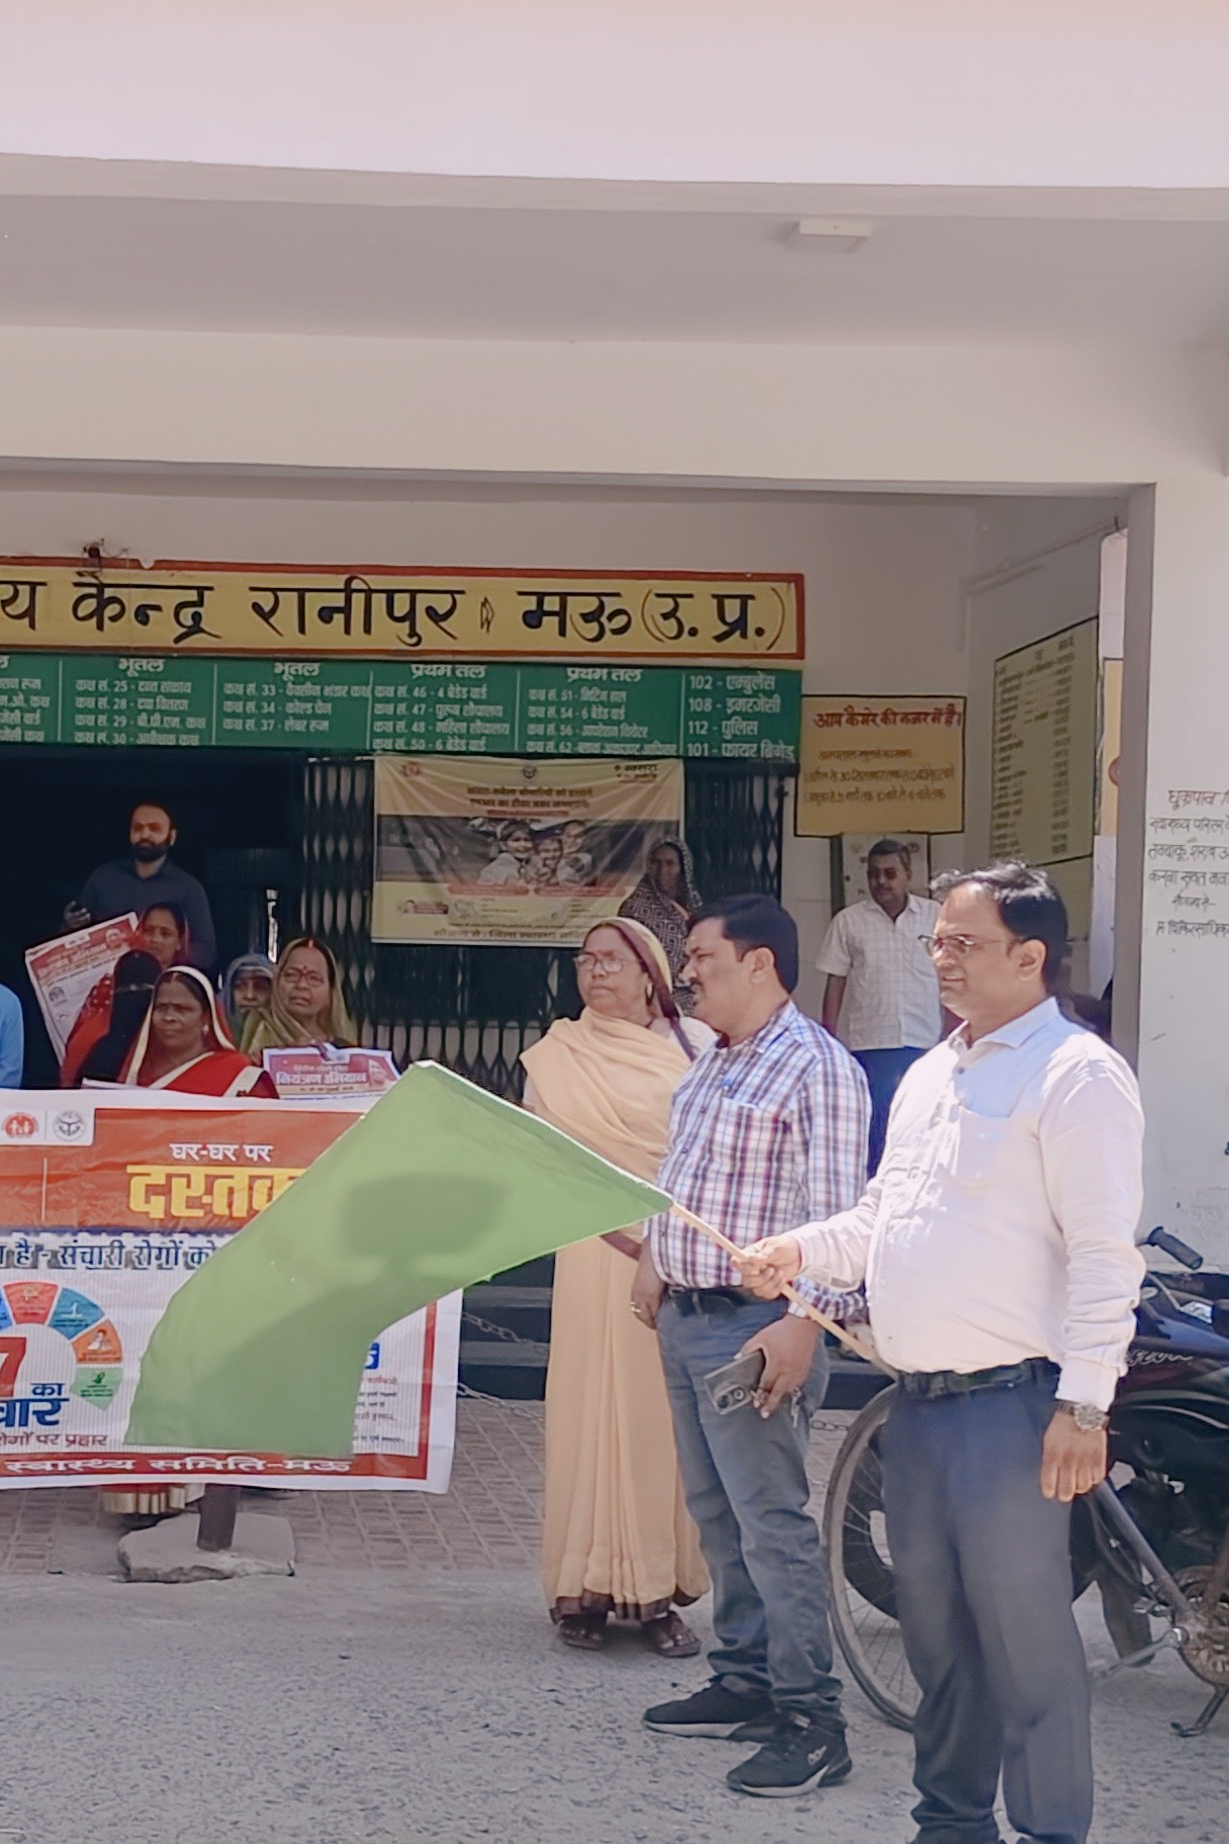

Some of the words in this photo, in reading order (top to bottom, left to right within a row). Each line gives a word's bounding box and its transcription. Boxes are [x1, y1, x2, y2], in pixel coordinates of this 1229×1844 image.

[71, 570, 222, 644] केन्द्र
[250, 575, 465, 647] रानीपुर
[118, 658, 165, 677] भूतल
[274, 663, 321, 681] भूतल
[455, 665, 487, 678] तल
[611, 669, 643, 682] तल
[690, 675, 713, 689] 102
[688, 698, 712, 712] 108
[688, 721, 708, 734] 112
[722, 716, 758, 739] पुलिस
[687, 743, 708, 756] 101
[169, 1143, 239, 1162] घर-घर
[243, 1145, 273, 1162] पर
[15, 1238, 31, 1267] है
[61, 1239, 125, 1267] संचारी
[134, 1239, 184, 1267] रोगों
[30, 1383, 65, 1396] का
[37, 1435, 60, 1446] पर
[65, 1435, 108, 1447] प्रहार
[4, 1458, 137, 1473] स्वास्थ्य
